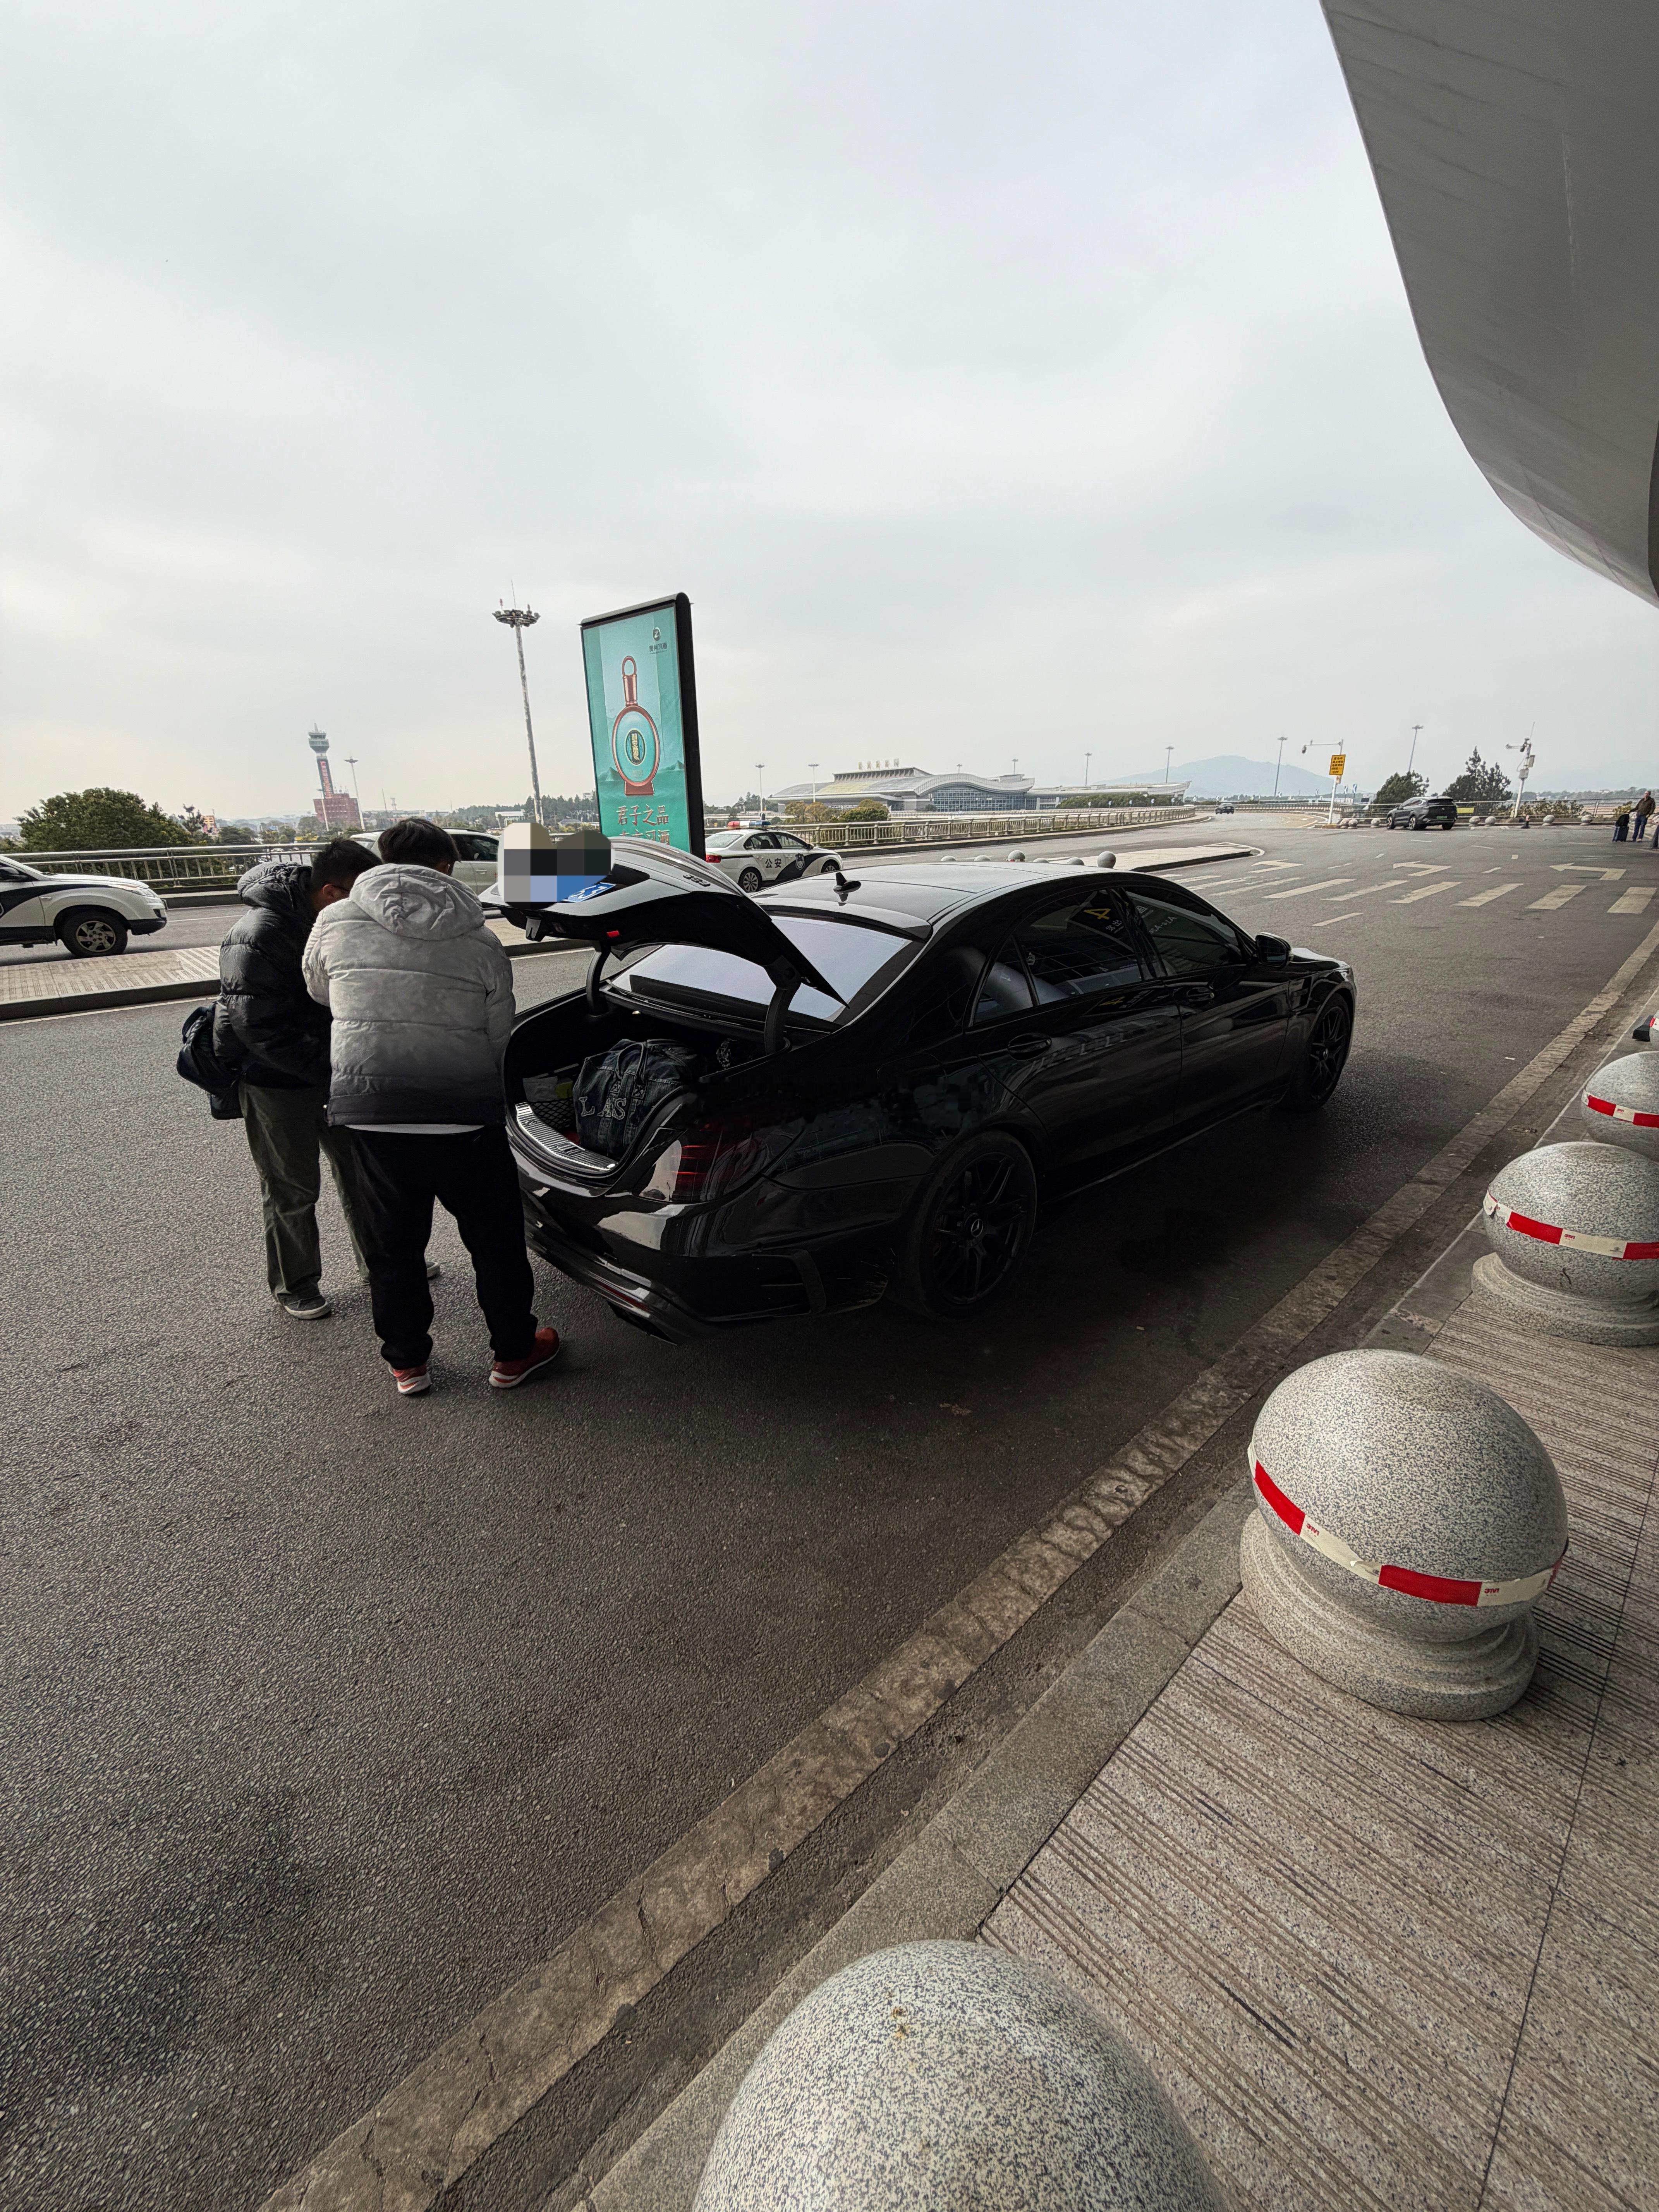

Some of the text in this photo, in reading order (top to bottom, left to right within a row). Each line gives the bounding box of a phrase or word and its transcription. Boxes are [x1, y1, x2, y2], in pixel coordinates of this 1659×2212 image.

[616, 804, 669, 826] 君子之品
[765, 858, 781, 868] 公安
[1306, 1523, 1319, 1536] 3M
